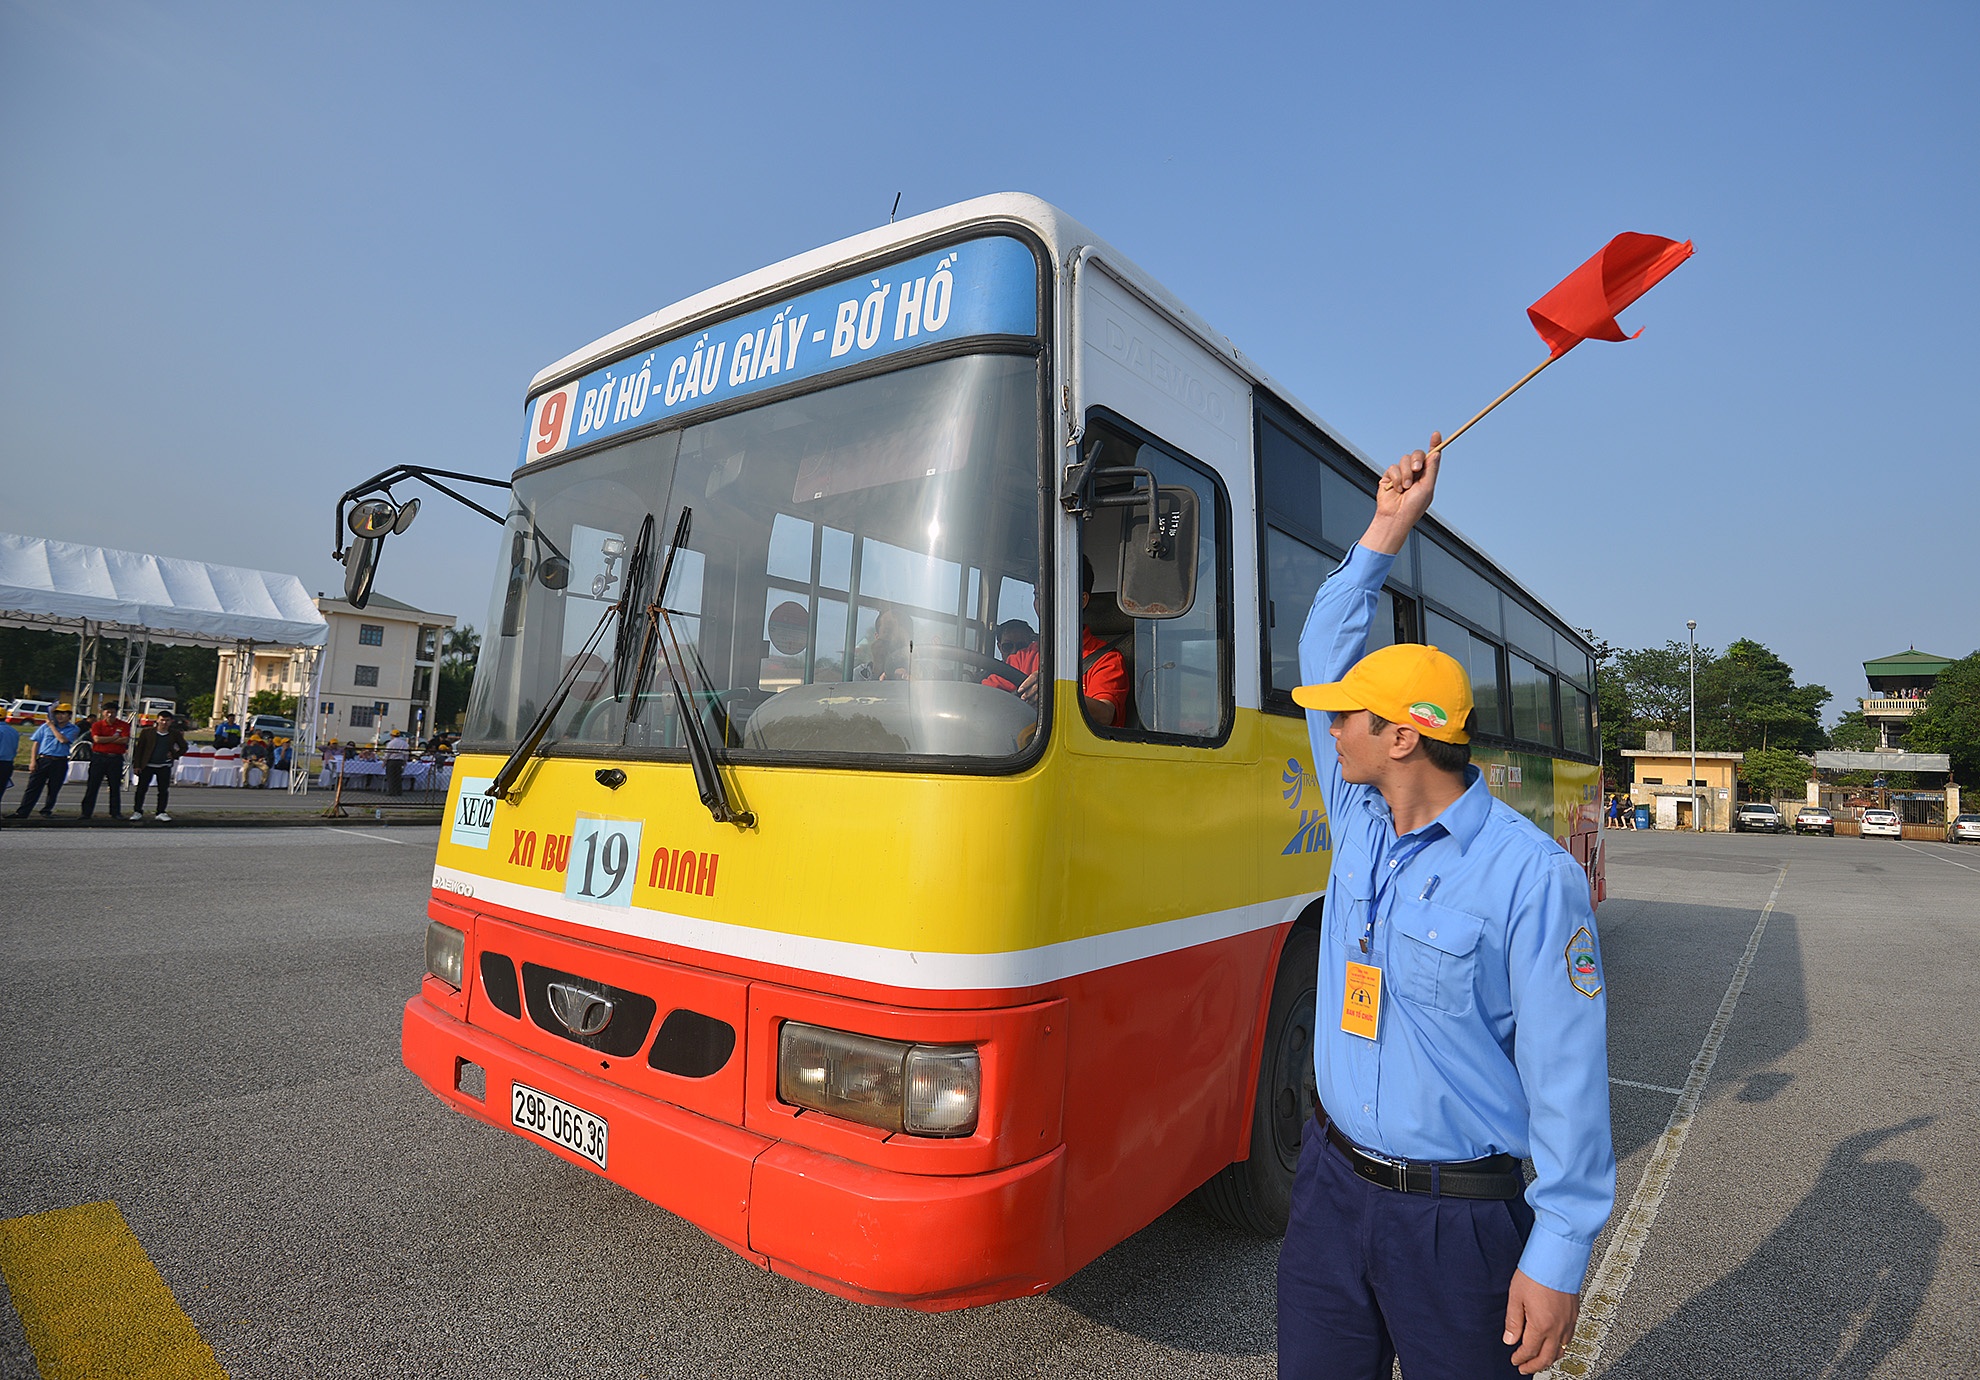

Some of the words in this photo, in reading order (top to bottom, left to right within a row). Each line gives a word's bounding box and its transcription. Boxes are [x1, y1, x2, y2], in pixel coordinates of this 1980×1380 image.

[577, 371, 615, 436] BỜ
[613, 352, 656, 425] HỒ
[663, 331, 723, 406] CẦU
[731, 305, 811, 386] GIẤY
[830, 279, 890, 358] BỜ
[893, 252, 959, 340] HỒ
[1105, 317, 1227, 426] DAEWOO
[535, 390, 568, 454] 9
[458, 797, 480, 826] XE
[478, 798, 494, 828] 02
[432, 876, 475, 898] DAEWOO
[576, 830, 630, 899] 19
[514, 1090, 606, 1163] 29B-066.36
